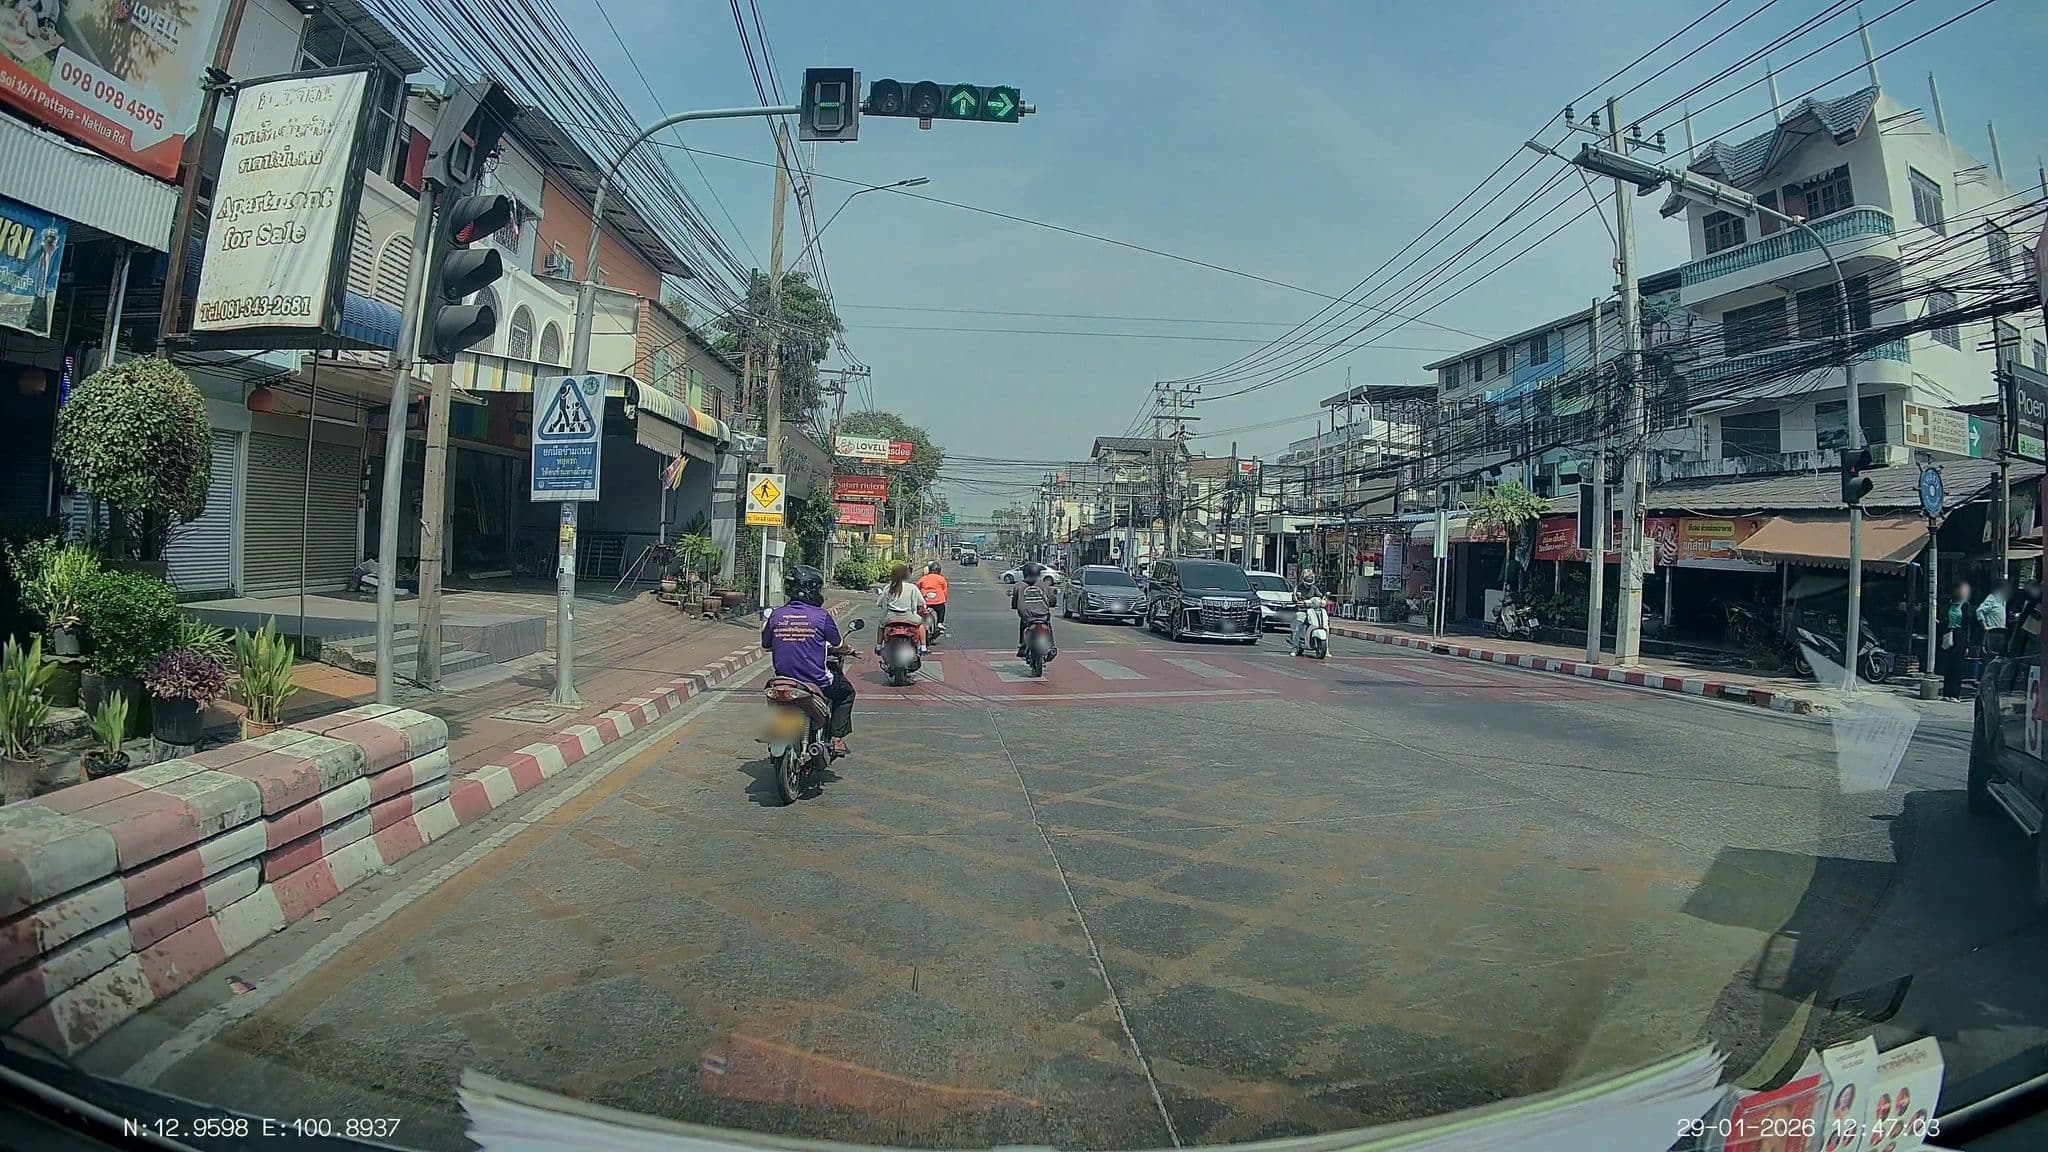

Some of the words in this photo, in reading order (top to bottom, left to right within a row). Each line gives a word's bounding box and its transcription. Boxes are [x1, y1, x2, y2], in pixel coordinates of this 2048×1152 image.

[0, 70, 16, 88] Soi
[17, 79, 38, 101] 16/1
[38, 93, 75, 119] Pattaya
[81, 113, 111, 138] Naklua
[112, 130, 126, 146] Rd.
[61, 62, 91, 92] 098
[95, 81, 124, 110] 098
[126, 100, 164, 131] 4595
[216, 187, 334, 222] Apartment
[222, 226, 253, 251] for
[256, 220, 307, 247] Sale
[2018, 389, 2046, 419] Ploen
[856, 442, 886, 452] LOVELL
